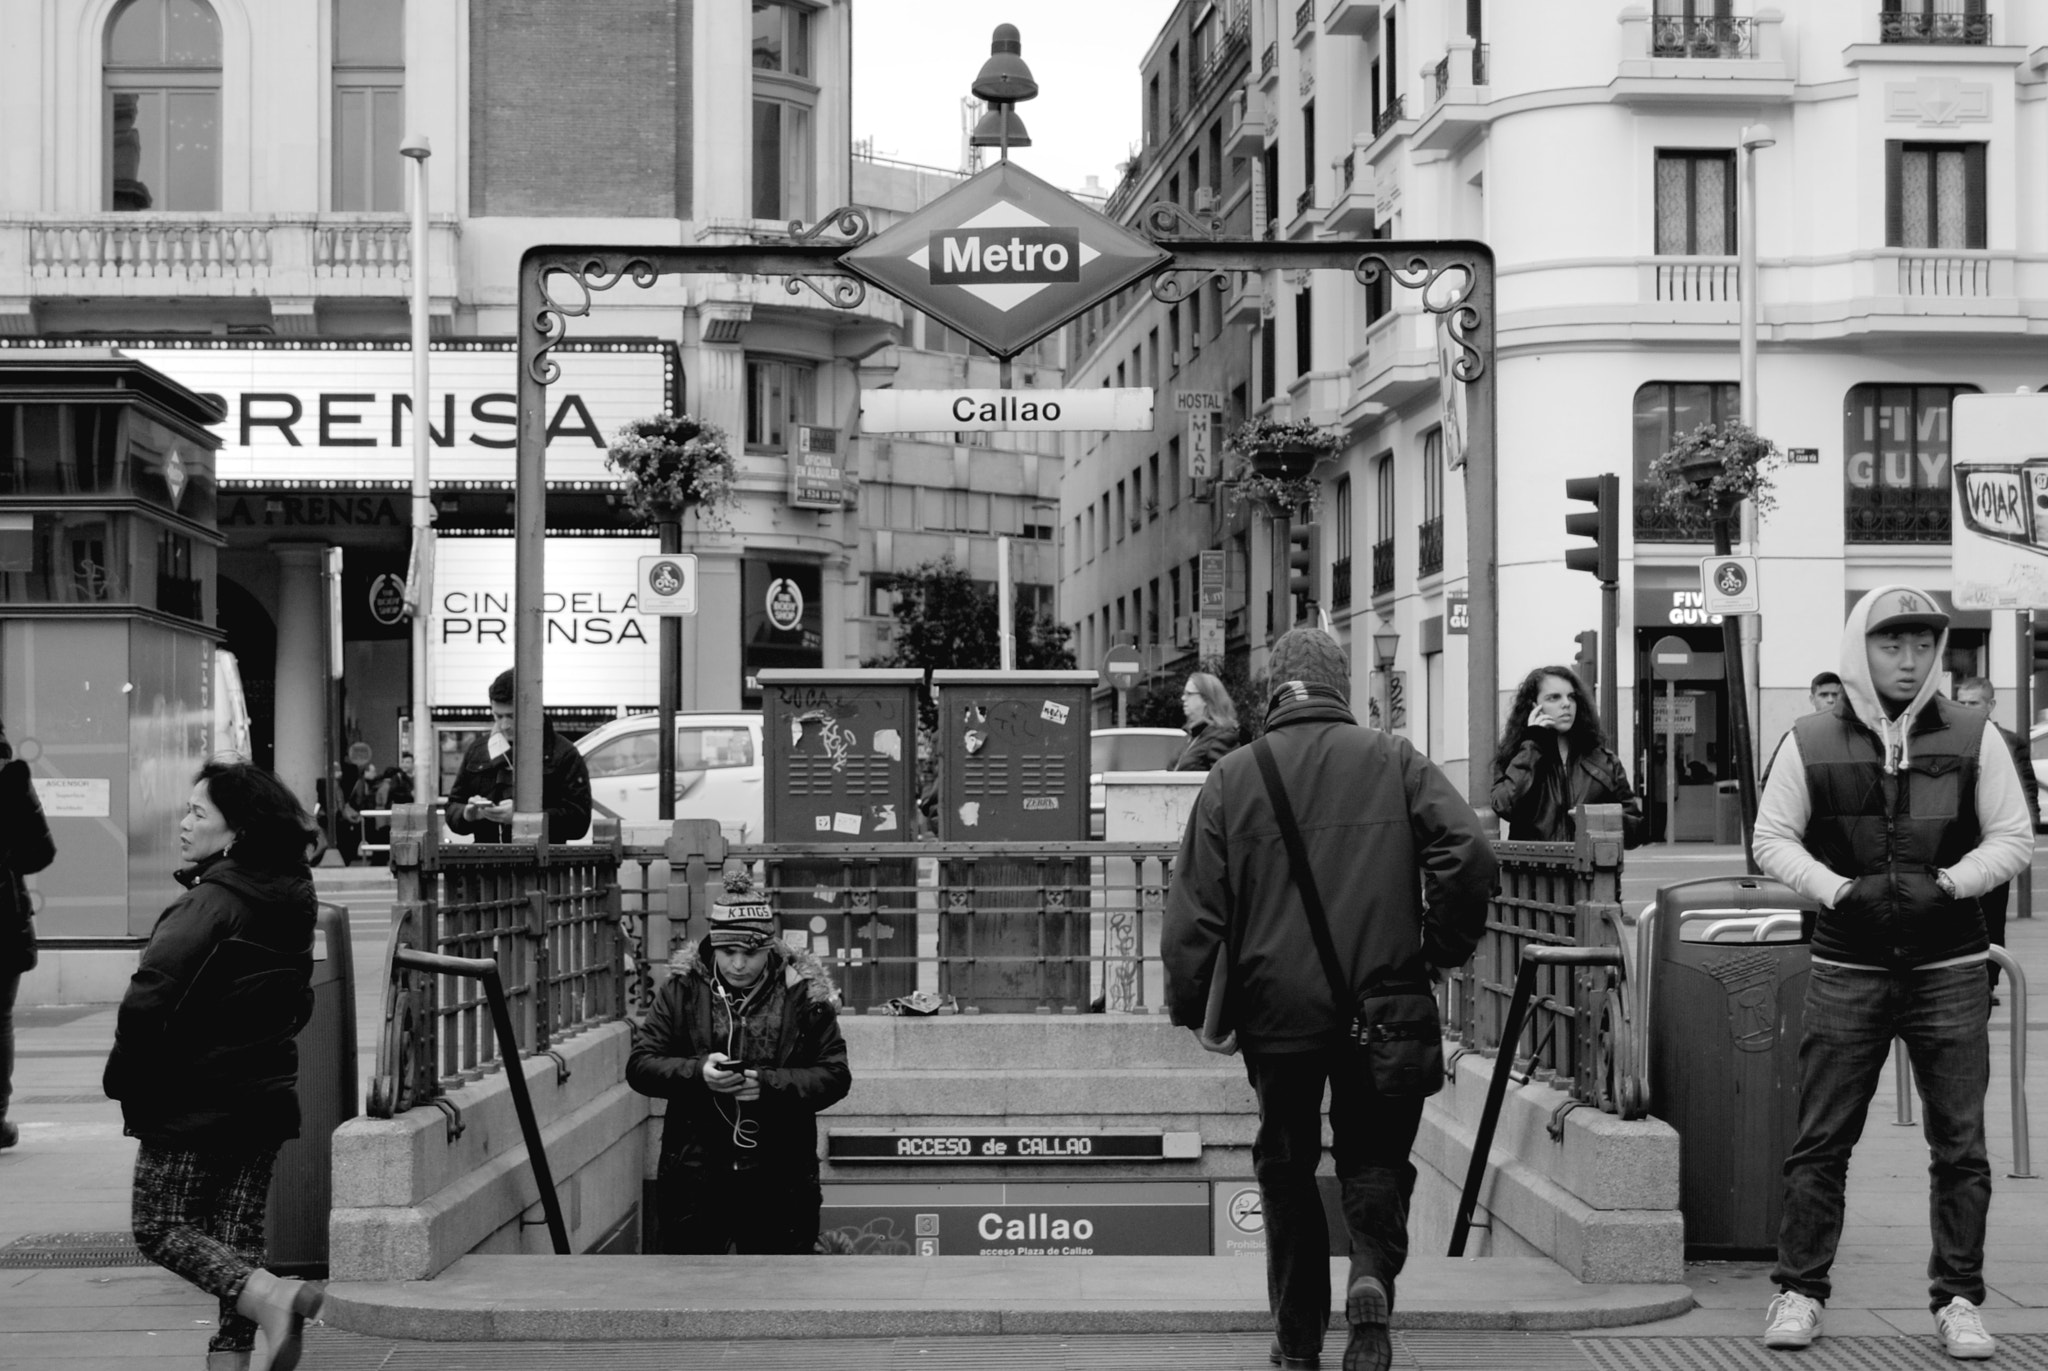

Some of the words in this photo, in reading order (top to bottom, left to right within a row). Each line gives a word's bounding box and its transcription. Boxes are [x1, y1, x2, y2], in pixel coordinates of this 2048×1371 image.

[942, 236, 1070, 273] Metro
[951, 395, 1062, 423] Callao
[1178, 393, 1221, 409] HOSTAL
[1192, 421, 1206, 476] MILAN
[1968, 474, 2022, 529] VOLAR
[773, 601, 796, 610] BODY
[774, 610, 795, 620] SHOP
[443, 618, 647, 644] PRNSA
[728, 906, 770, 918] KINGS
[897, 1138, 971, 1155] ACCESO
[982, 1138, 1007, 1155] de
[1018, 1138, 1092, 1155] CALLAO
[921, 1217, 933, 1232] 3
[978, 1213, 1094, 1240] Callao
[921, 1241, 934, 1256] 5
[1018, 1247, 1044, 1256] Plaza
[1047, 1247, 1060, 1256] de
[1062, 1247, 1094, 1256] Callao
